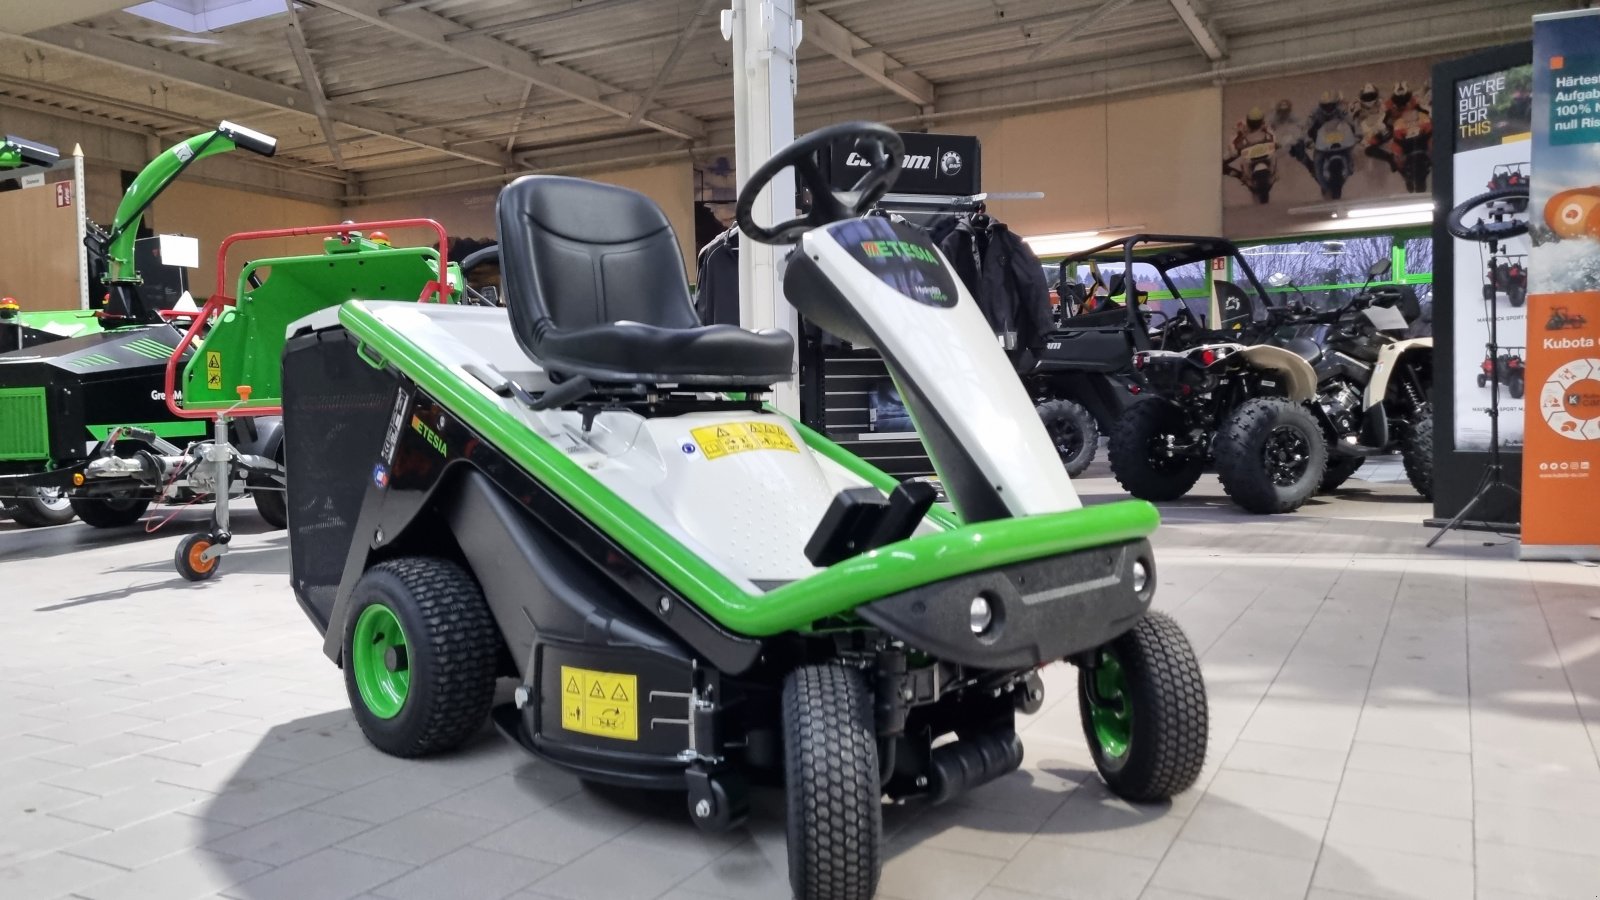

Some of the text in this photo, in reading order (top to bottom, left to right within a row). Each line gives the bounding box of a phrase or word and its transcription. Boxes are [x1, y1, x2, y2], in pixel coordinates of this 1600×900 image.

[1459, 77, 1505, 98] WE'RE
[1460, 91, 1499, 112] BUILT
[1556, 104, 1591, 116] 100%
[1460, 108, 1487, 125] FOR
[1555, 118, 1578, 130] null
[1459, 120, 1491, 138] THIS
[876, 241, 939, 265] ETESIA
[1544, 337, 1594, 349] Kubota
[417, 419, 447, 458] ETESIA
